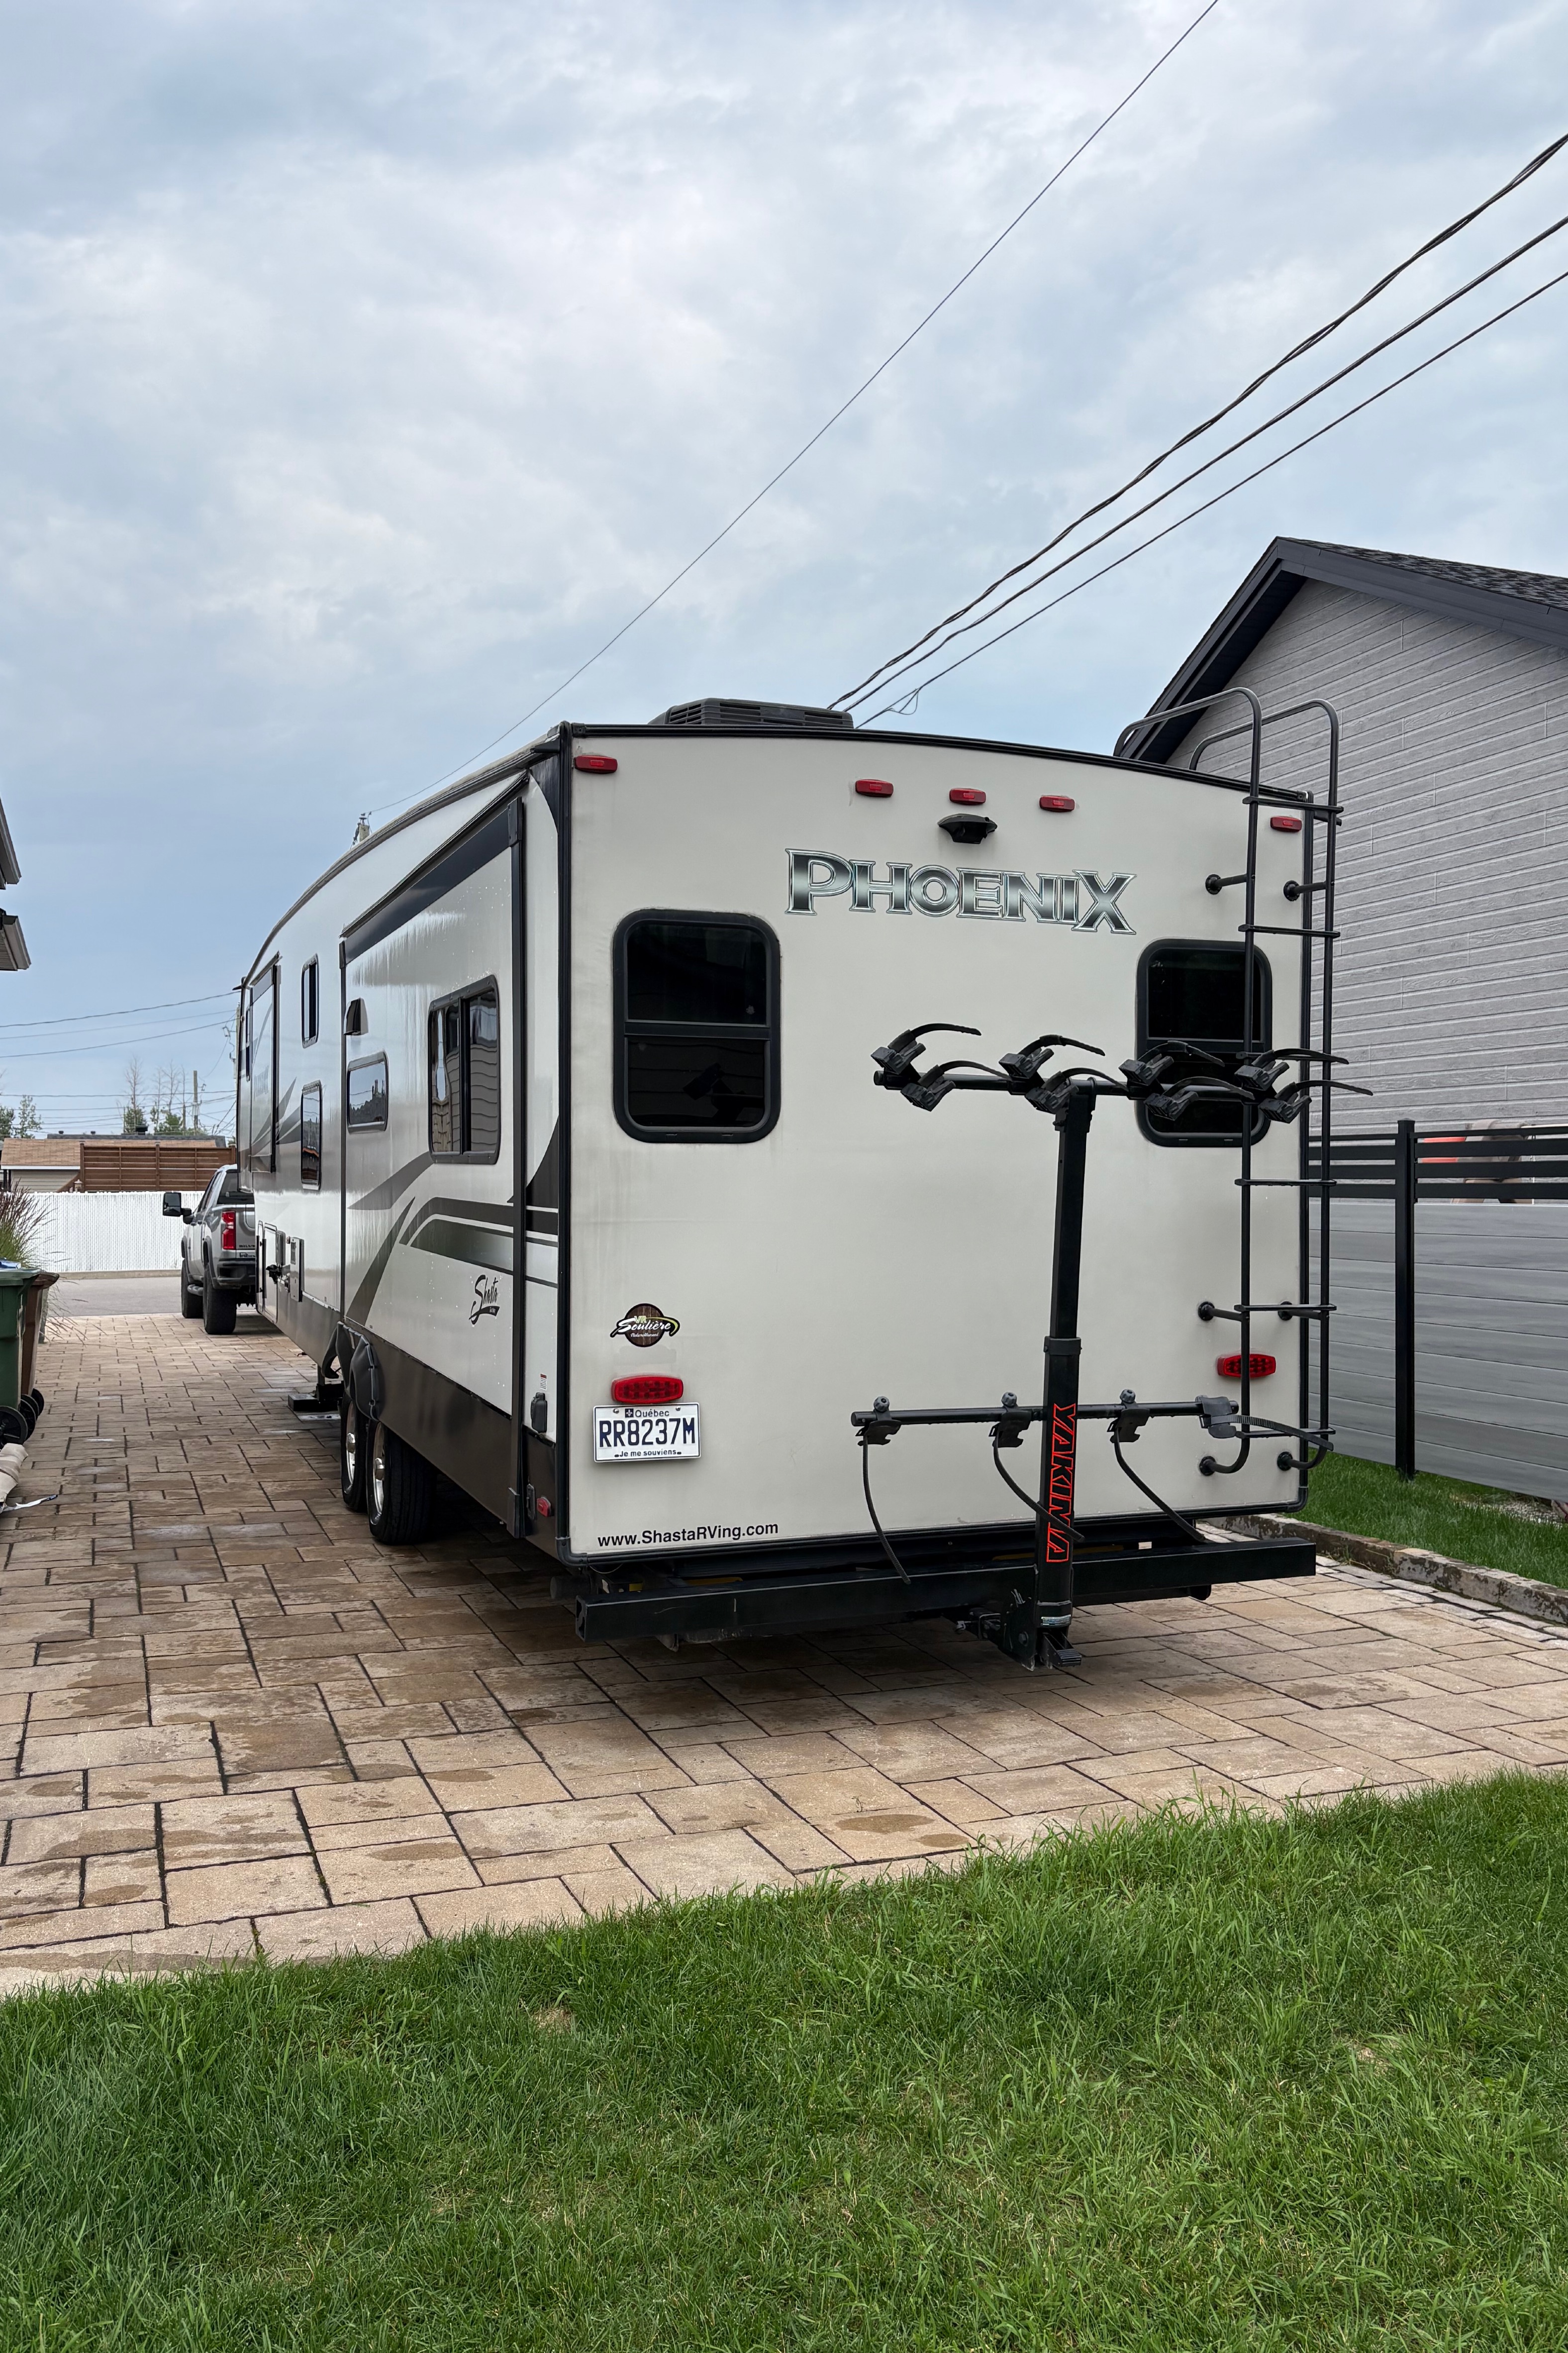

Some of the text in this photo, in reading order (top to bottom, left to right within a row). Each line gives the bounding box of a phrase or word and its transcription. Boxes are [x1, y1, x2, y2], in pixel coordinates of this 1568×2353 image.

[785, 848, 1137, 935] PHOENIX
[469, 1274, 499, 1325] Shasta
[617, 1318, 671, 1333] Soulière
[634, 1315, 647, 1324] VR
[635, 1409, 670, 1418] Québec
[599, 1417, 695, 1447] RR8237M
[597, 1524, 779, 1547] www.ShastaRVing.com
